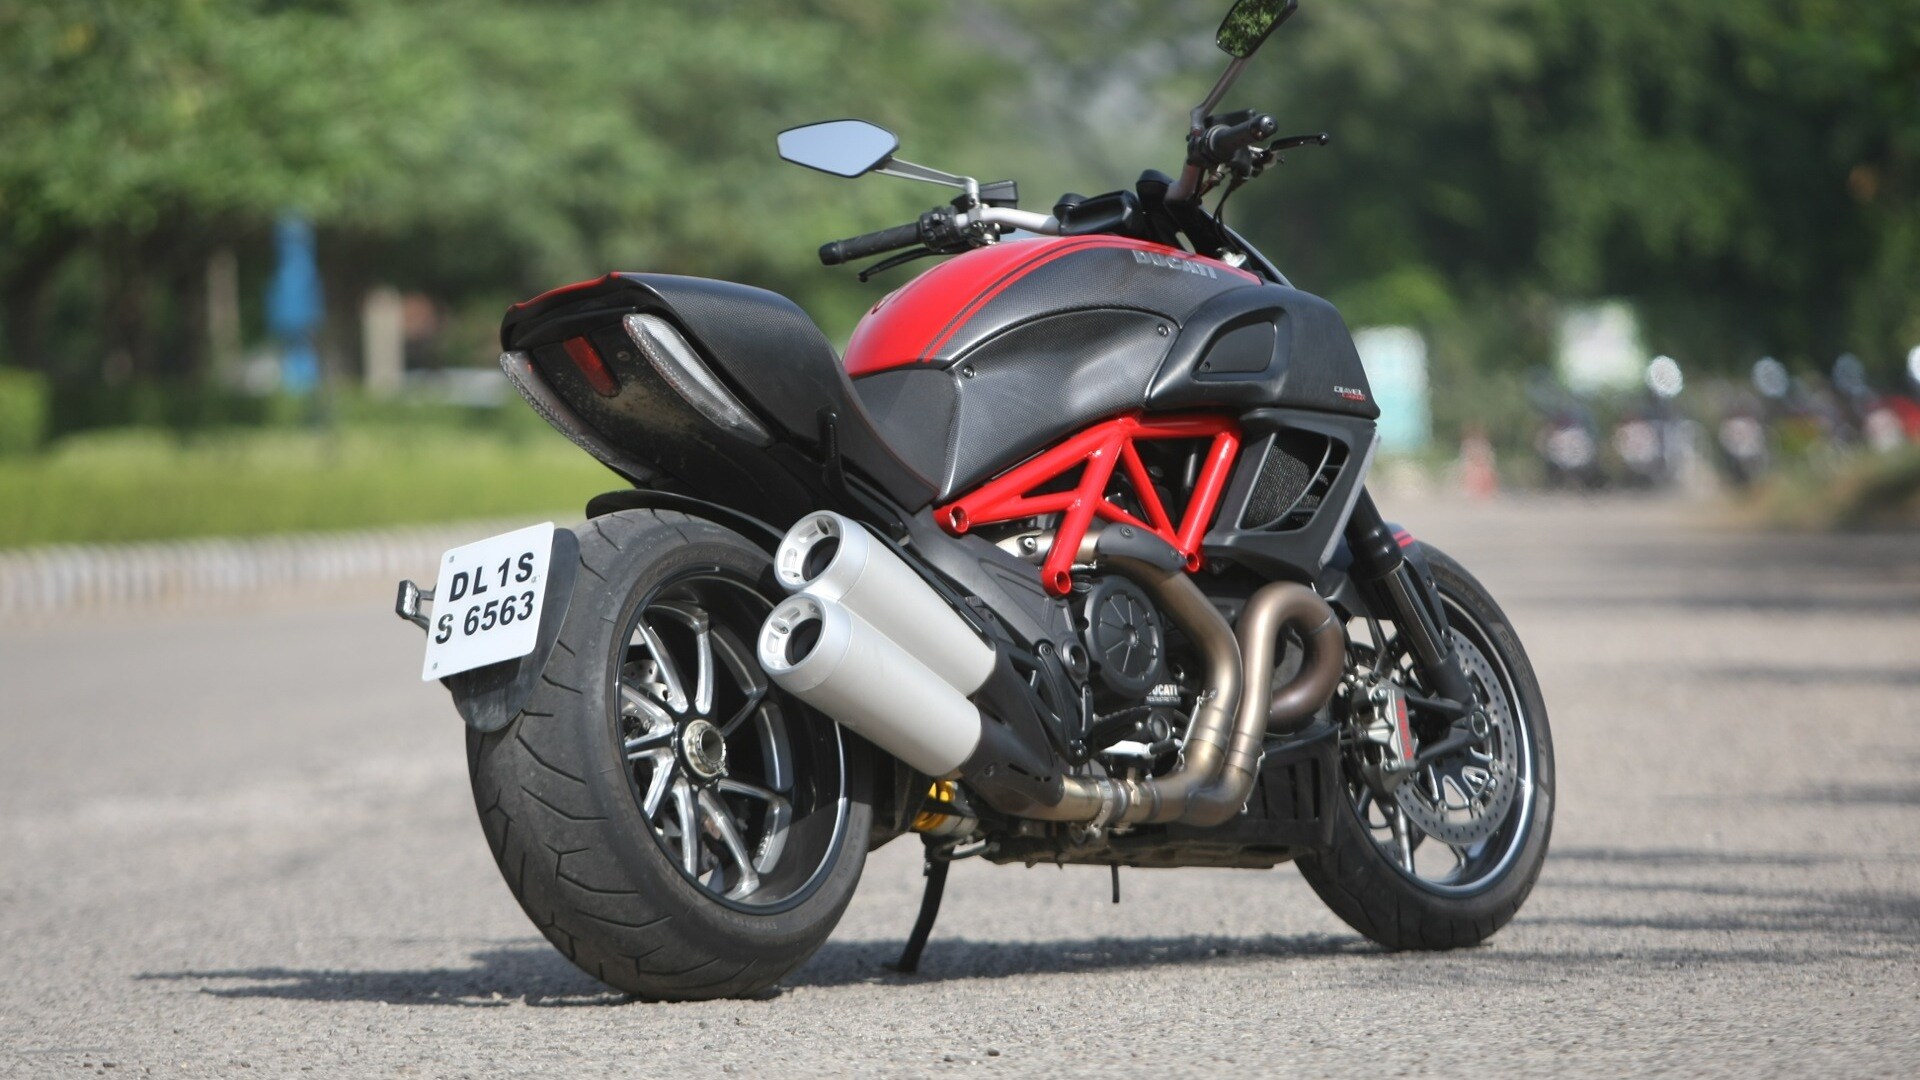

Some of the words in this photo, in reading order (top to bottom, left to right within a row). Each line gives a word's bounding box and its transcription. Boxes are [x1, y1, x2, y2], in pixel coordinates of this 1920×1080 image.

[1132, 249, 1218, 279] DUCATI
[449, 566, 488, 602] DL
[497, 552, 534, 586] 1S
[435, 613, 454, 644] S
[463, 591, 535, 636] 6563
[1148, 684, 1178, 696] UCATI
